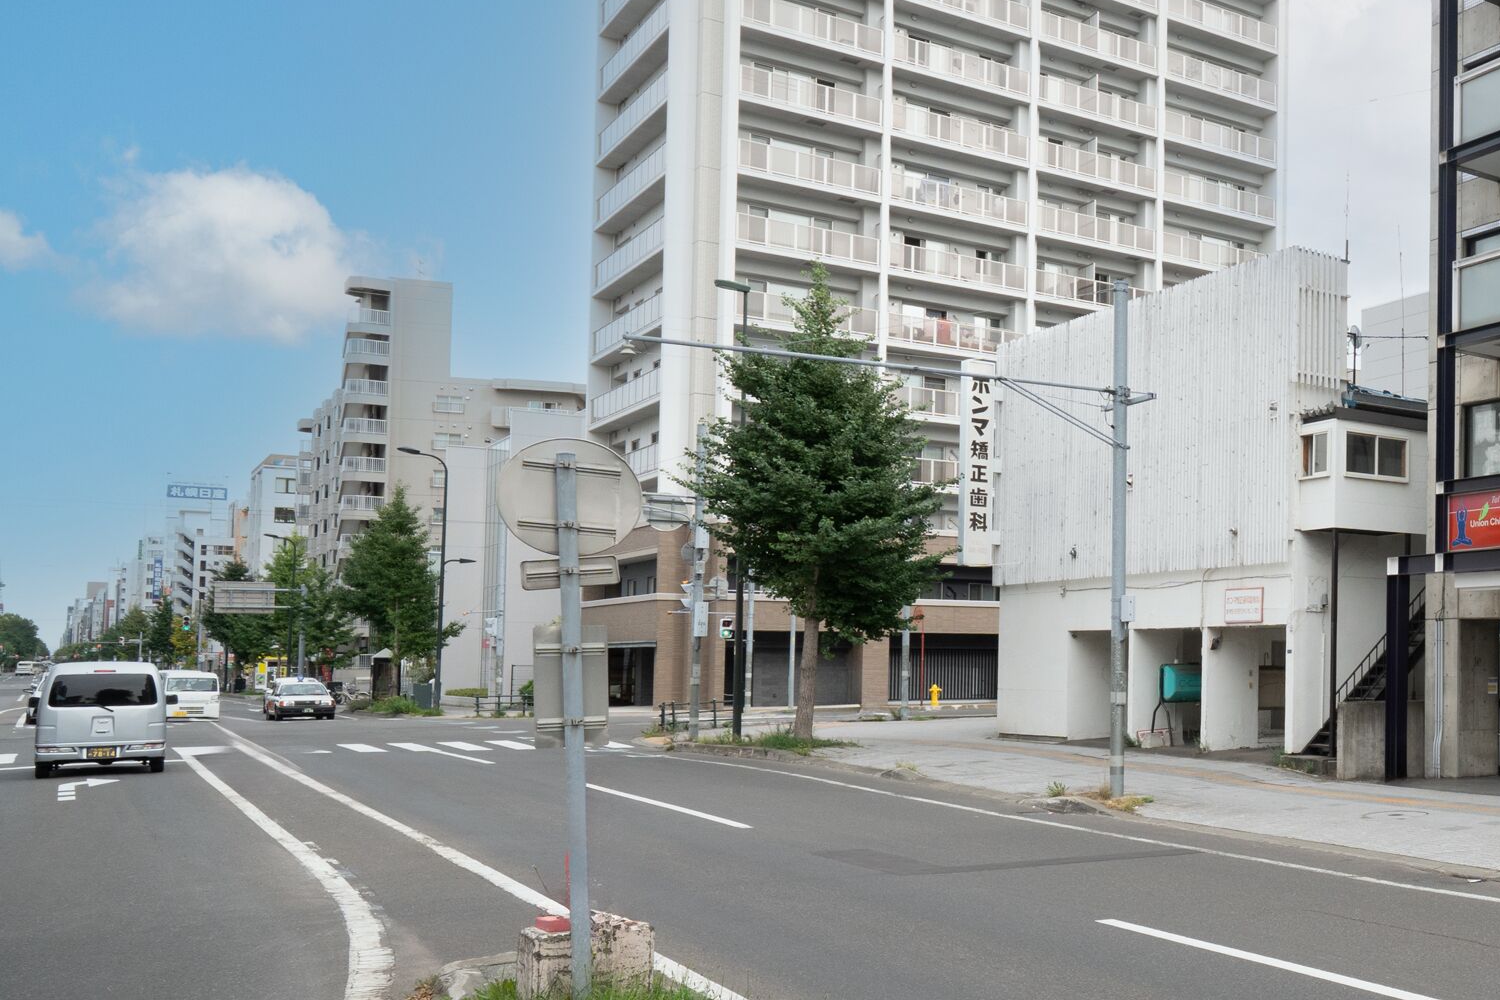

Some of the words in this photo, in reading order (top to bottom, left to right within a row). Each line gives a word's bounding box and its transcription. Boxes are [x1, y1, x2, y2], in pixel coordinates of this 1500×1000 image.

[969, 376, 990, 532] ホンマ矯正歯科
[169, 486, 226, 499] 札幌日産
[1491, 495, 1500, 504] Tel
[1470, 518, 1489, 528] Union
